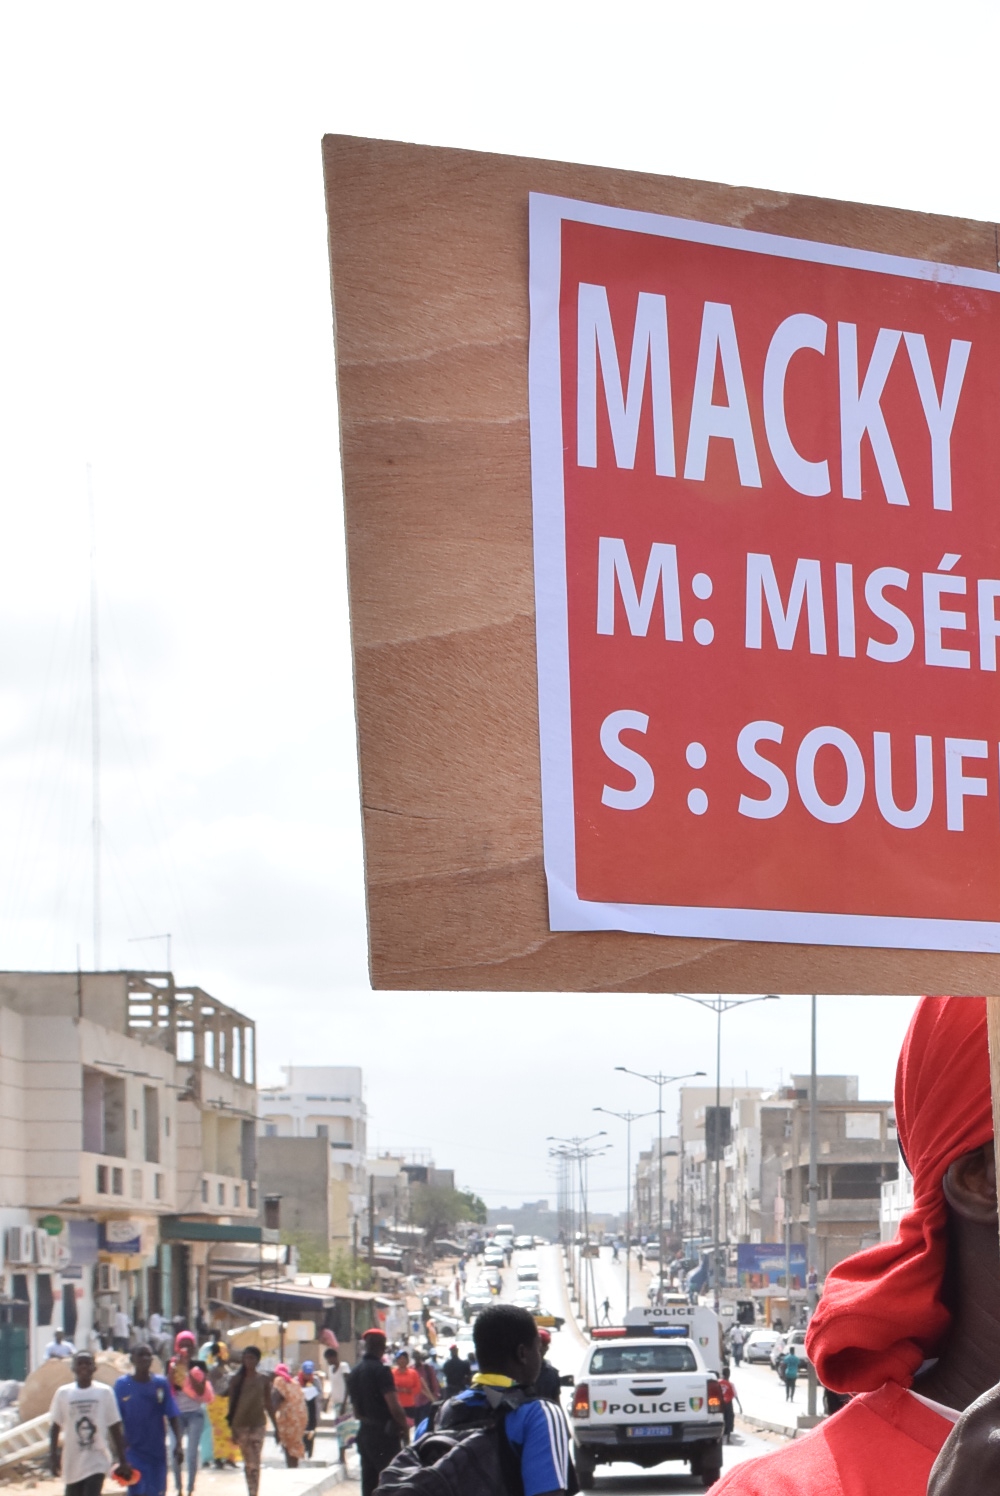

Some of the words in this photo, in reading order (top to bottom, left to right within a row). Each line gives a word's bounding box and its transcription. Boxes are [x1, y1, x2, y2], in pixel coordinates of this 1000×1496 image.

[577, 283, 972, 511] MACKY
[643, 1307, 695, 1317] POLICE
[608, 1401, 687, 1415] POLICE
